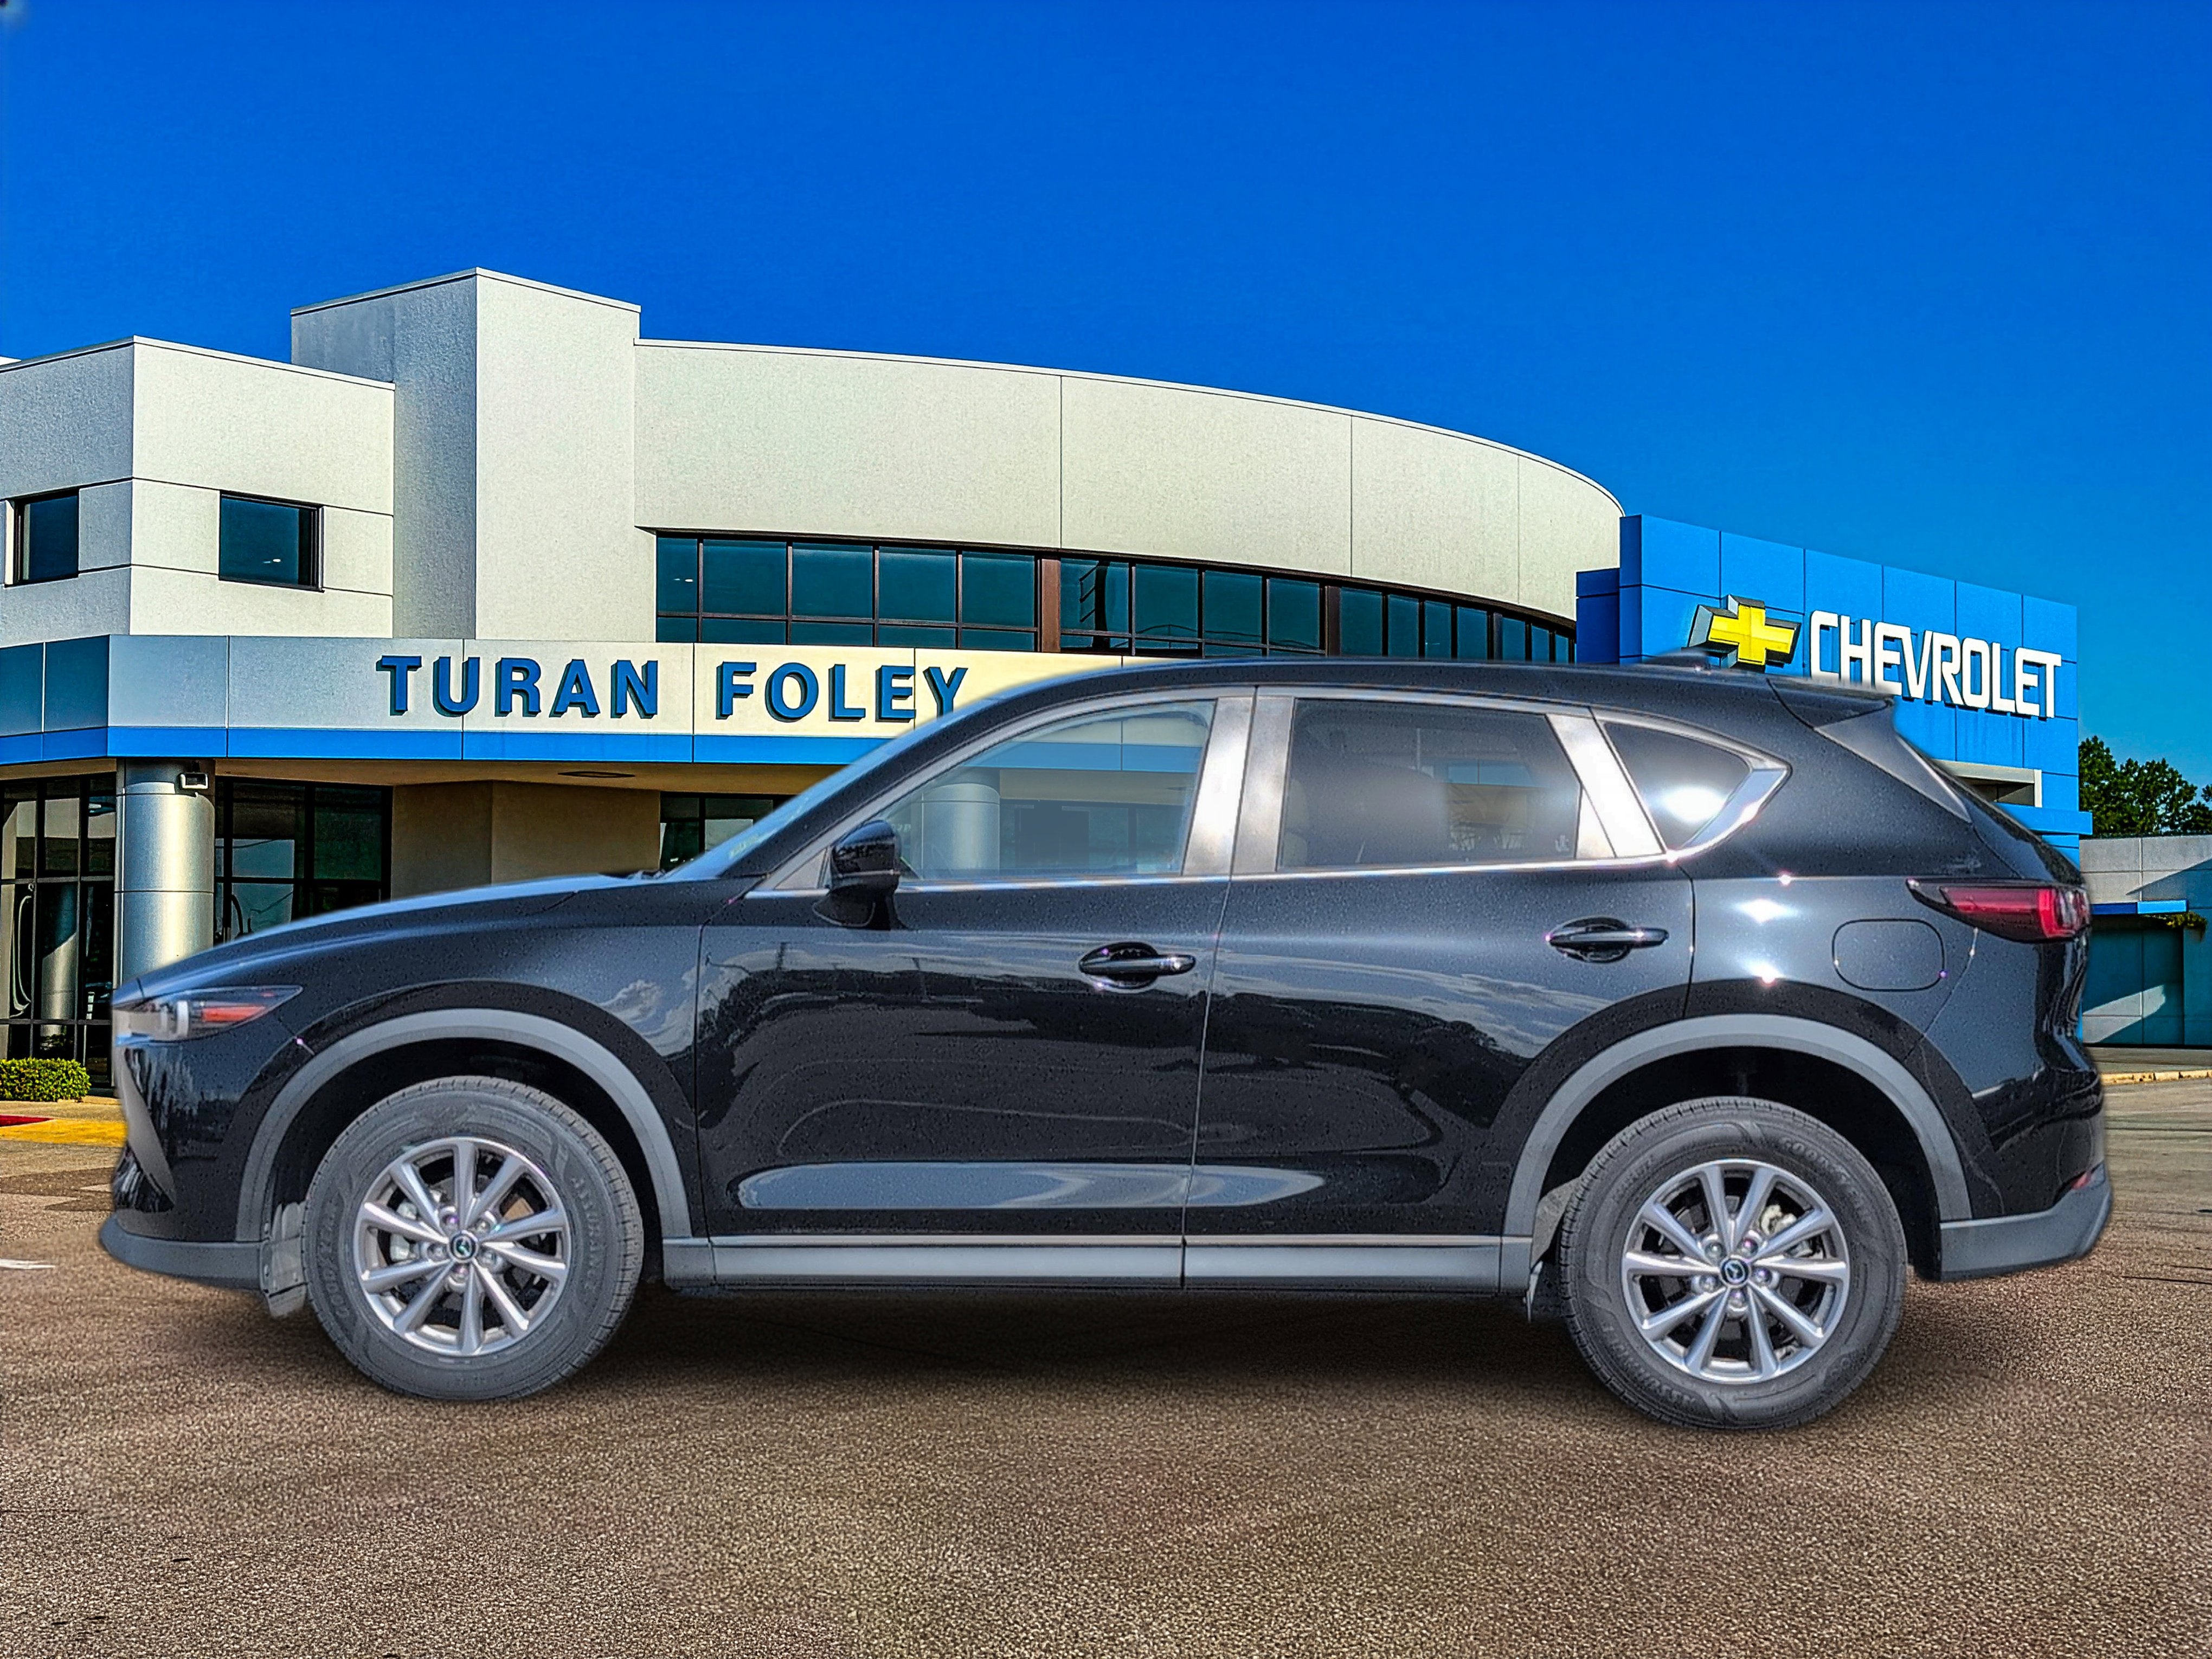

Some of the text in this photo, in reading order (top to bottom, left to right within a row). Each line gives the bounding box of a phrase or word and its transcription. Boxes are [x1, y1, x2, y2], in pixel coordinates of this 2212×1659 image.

[376, 655, 968, 723] TURAN FOLEY
[1811, 610, 2062, 718] CHEVROLET
